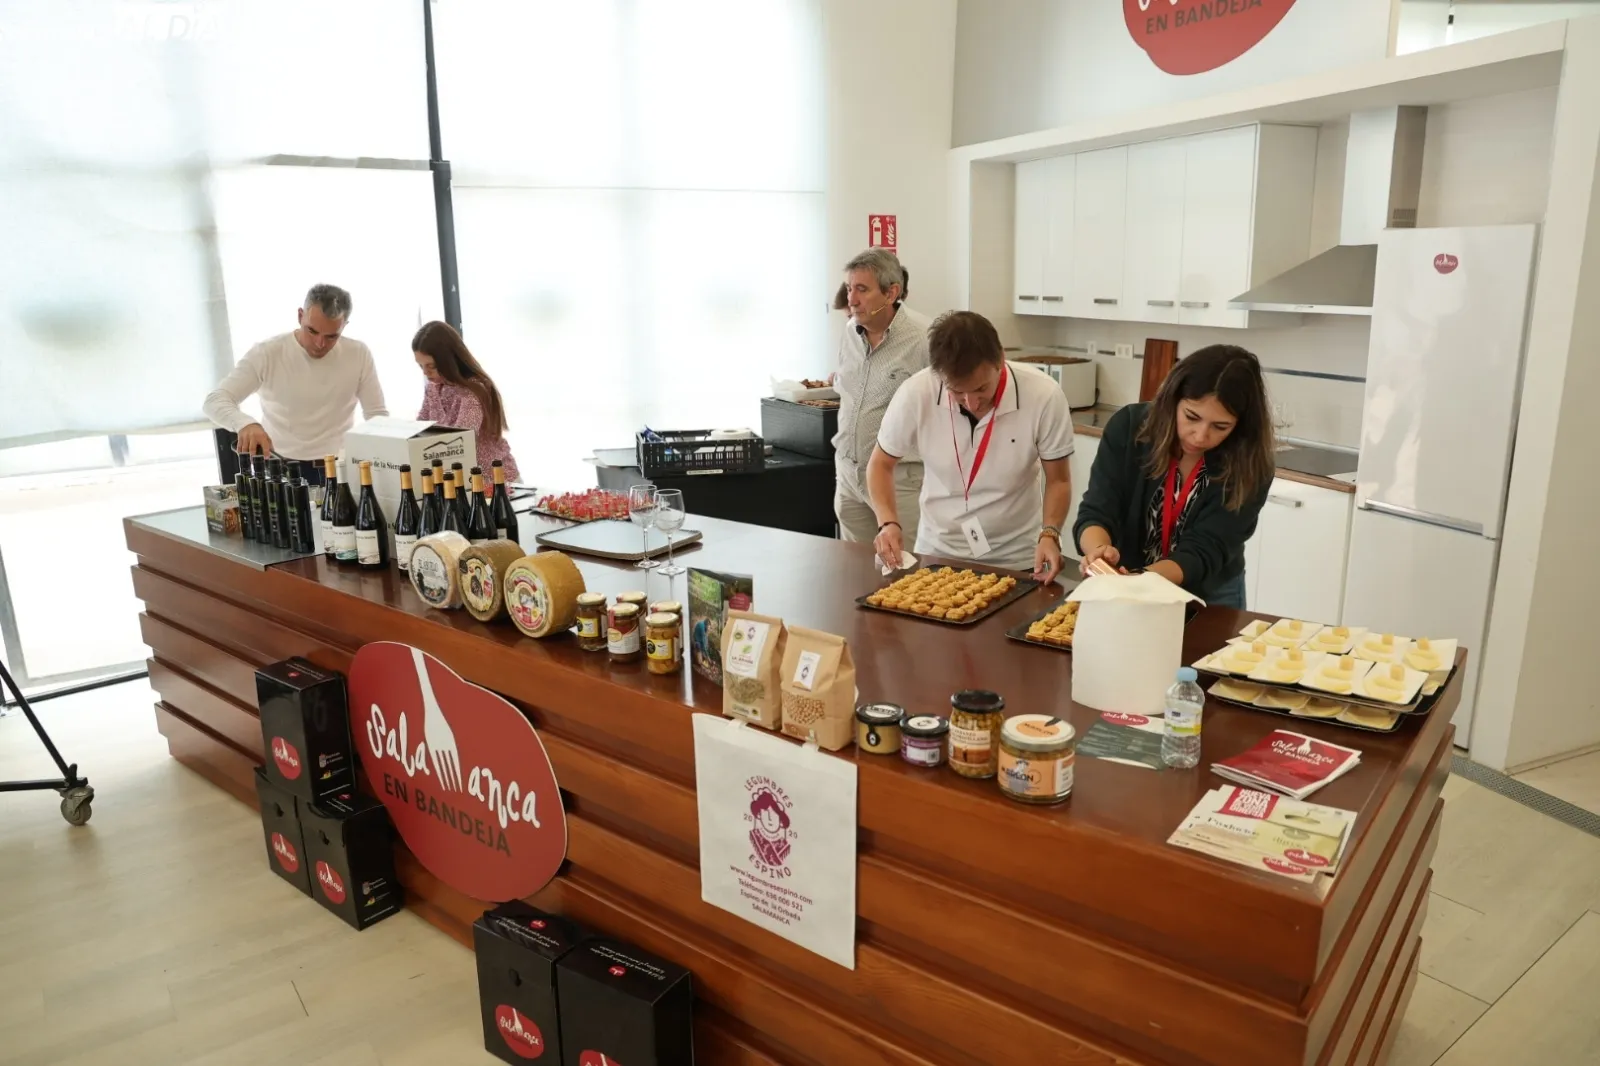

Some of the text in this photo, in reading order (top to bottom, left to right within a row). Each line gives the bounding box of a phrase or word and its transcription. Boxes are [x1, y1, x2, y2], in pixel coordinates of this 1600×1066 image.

[1146, 14, 1169, 35] EN
[387, 462, 402, 471] Sierr
[423, 448, 464, 461] Salamanca
[366, 703, 541, 829] Salamanca
[1285, 752, 1320, 766] BANDEJA
[744, 775, 794, 809] LEGUMBRES
[383, 773, 513, 857] EN BANDEJA
[748, 853, 792, 879] ESPINO
[752, 903, 791, 927] SALAMANCA
